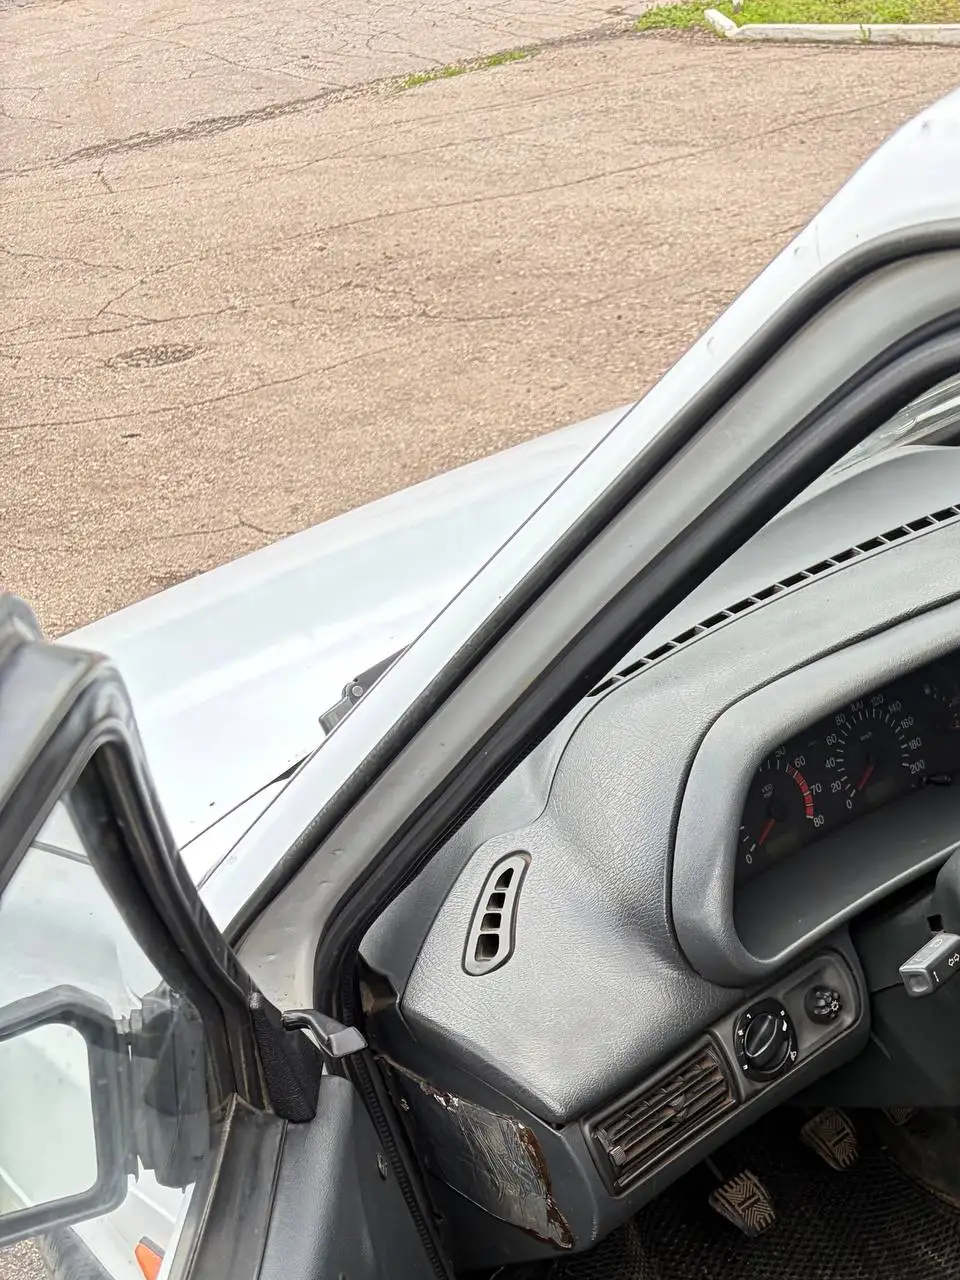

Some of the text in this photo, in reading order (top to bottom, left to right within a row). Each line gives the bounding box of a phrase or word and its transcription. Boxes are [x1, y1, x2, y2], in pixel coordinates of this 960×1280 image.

[826, 734, 837, 746] 60
[795, 756, 805, 768] 60
[825, 757, 836, 769] 40
[910, 760, 925, 774] 200
[810, 783, 822, 796] 70
[831, 781, 841, 793] 20
[846, 799, 853, 809] 0
[814, 815, 825, 828] 80
[745, 854, 753, 864] 0
